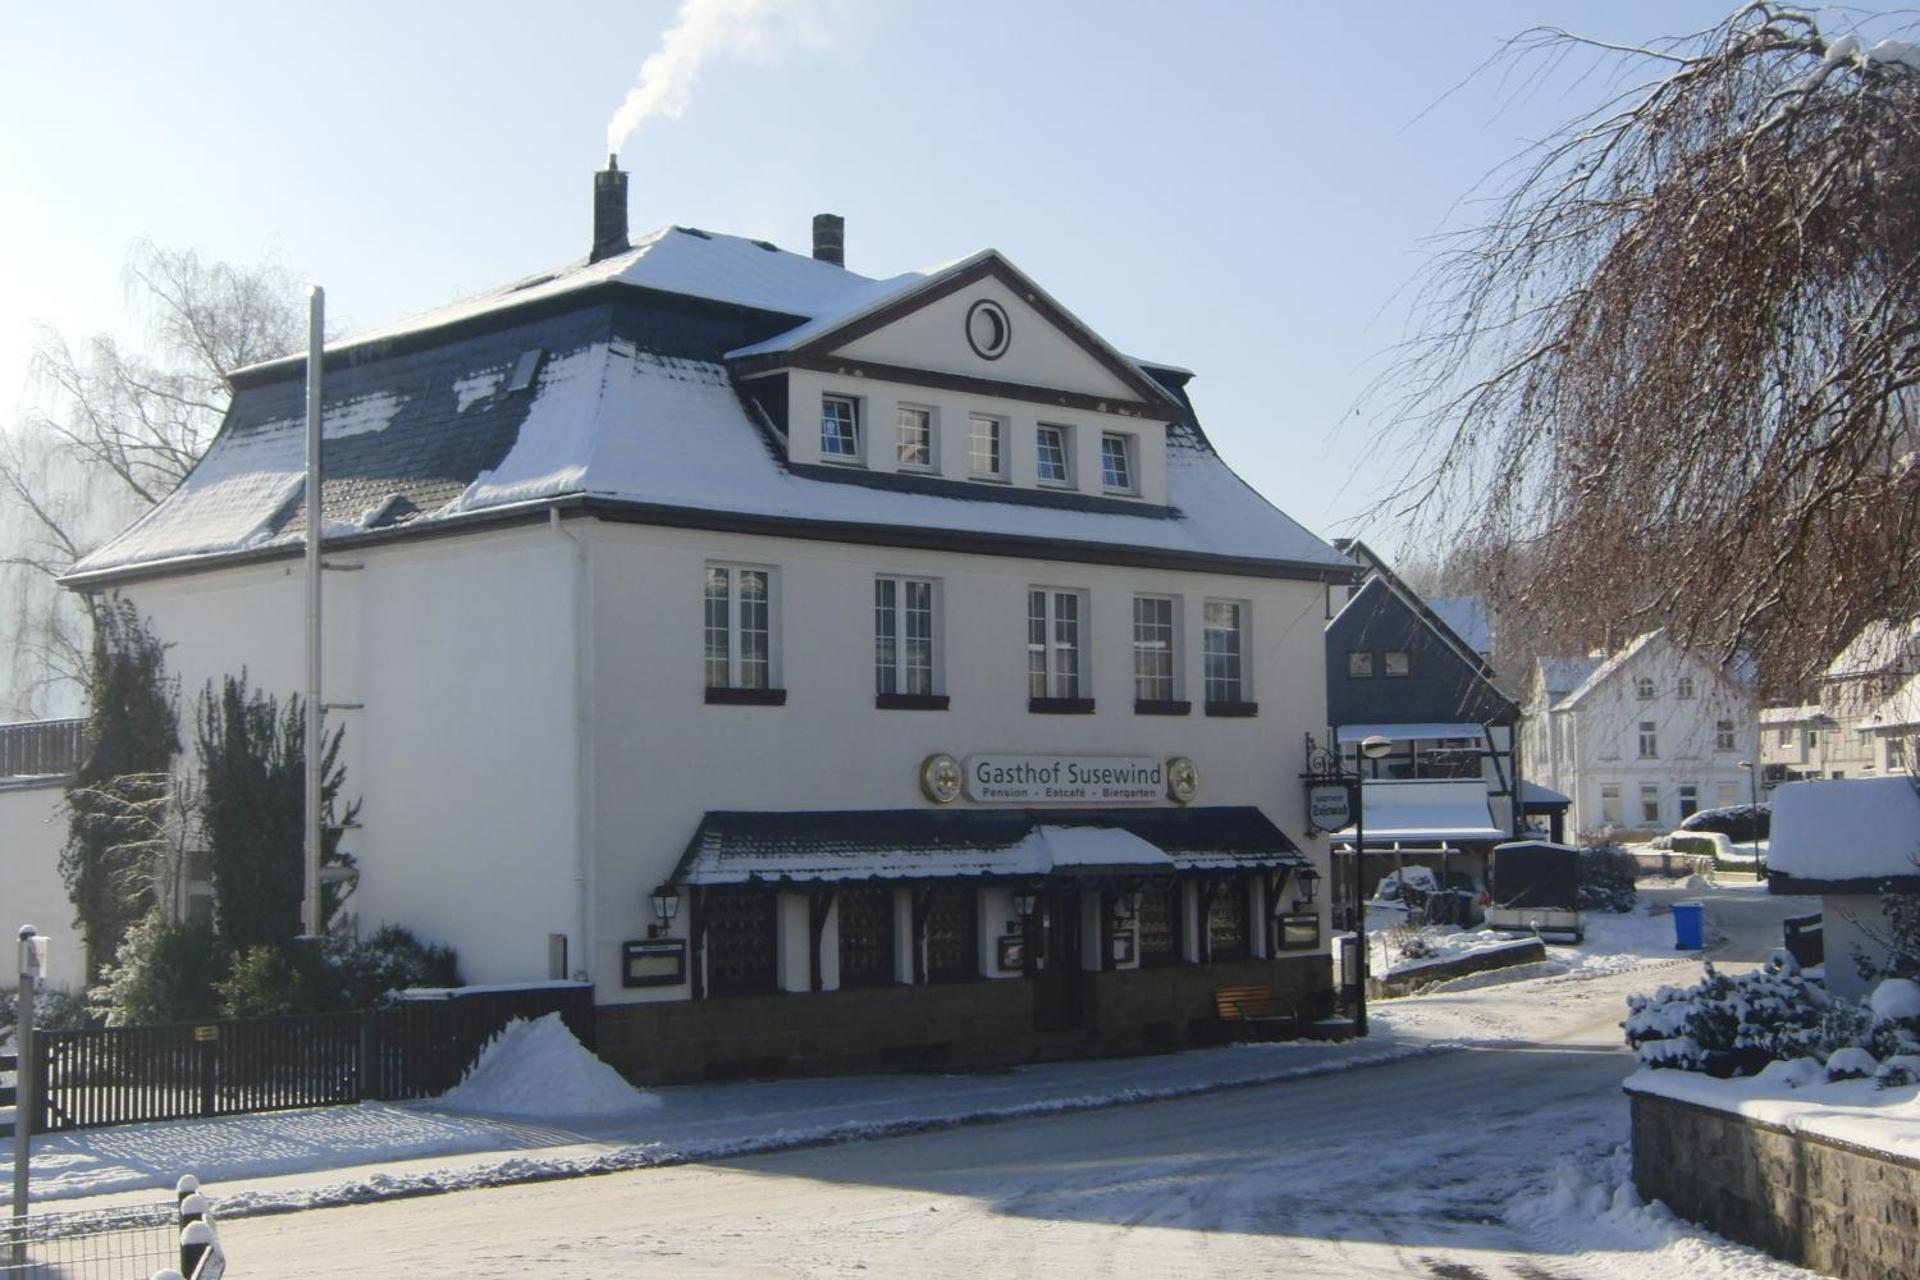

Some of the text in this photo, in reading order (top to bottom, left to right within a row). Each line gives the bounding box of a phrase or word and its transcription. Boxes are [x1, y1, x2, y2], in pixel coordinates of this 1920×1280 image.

[976, 762, 1161, 784] Gasthof Susewind
[983, 787, 1028, 798] Pension
[1102, 787, 1156, 799] Biergarten
